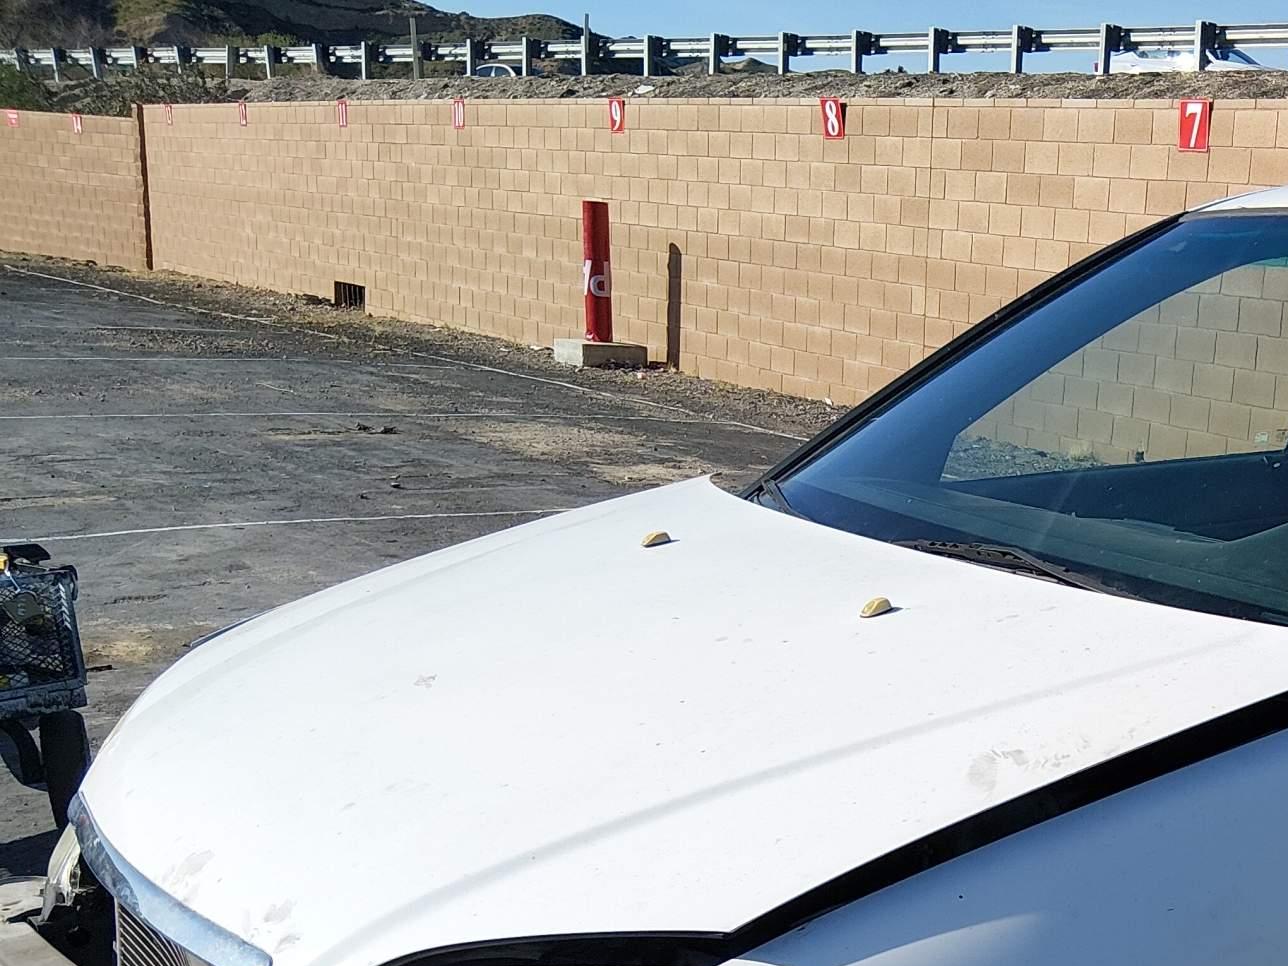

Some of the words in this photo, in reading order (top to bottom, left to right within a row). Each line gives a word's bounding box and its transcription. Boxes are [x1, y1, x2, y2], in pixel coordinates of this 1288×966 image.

[338, 102, 347, 126] 11
[453, 101, 464, 126] 10
[611, 100, 621, 131] 9
[825, 100, 839, 136] 8
[1185, 102, 1203, 148] 7
